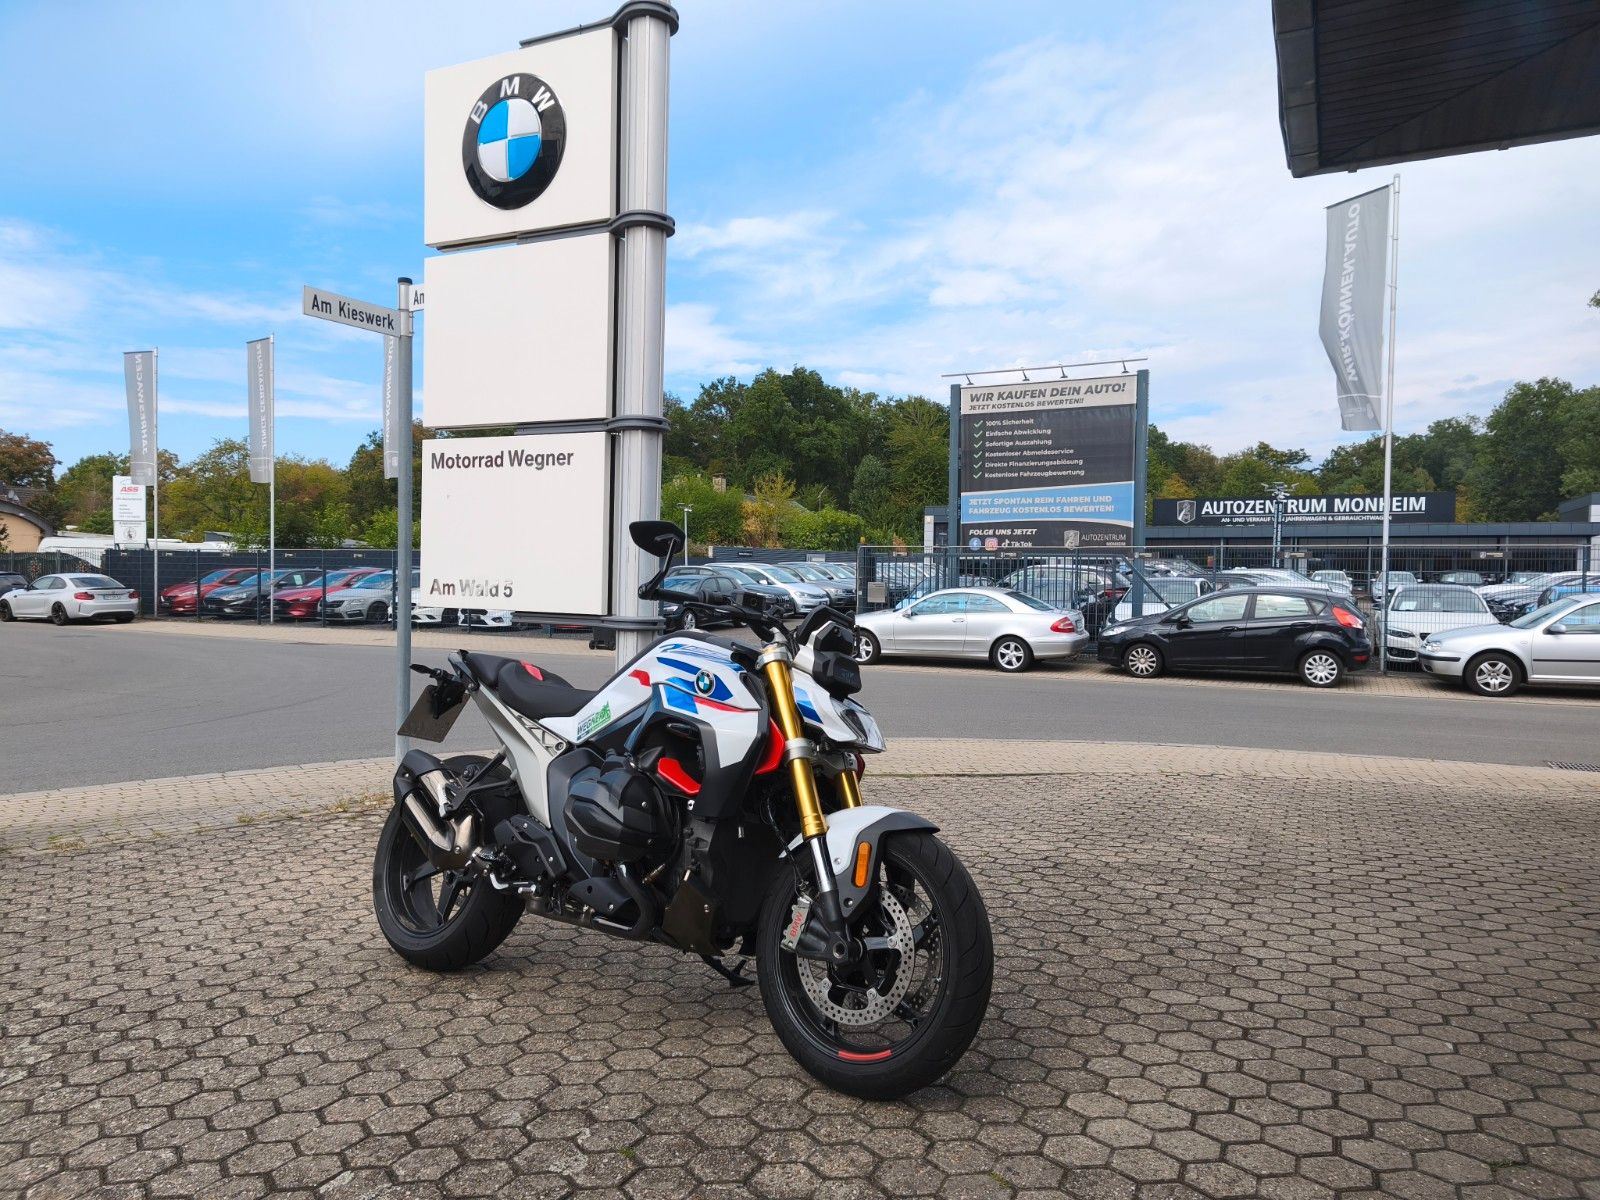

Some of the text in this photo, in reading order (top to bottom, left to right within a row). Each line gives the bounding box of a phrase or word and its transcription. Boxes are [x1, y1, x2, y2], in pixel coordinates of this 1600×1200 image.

[470, 76, 555, 125] BMW
[311, 294, 395, 331] Am Kieswerk
[969, 383, 1127, 403] WIR KAUFEN DEIN AUTO!
[969, 403, 991, 411] JETZT
[992, 401, 1035, 409] KOSTENLOS
[1002, 418, 1034, 426] Sicherheit
[1013, 428, 1052, 436] Abwicklung
[1022, 448, 1074, 456] Abmeldeservice
[431, 449, 574, 470] Motorrad Wegner
[1020, 469, 1085, 478] Fahrzeugbewertung
[969, 498, 992, 506] JETZT
[993, 497, 1032, 505] SPONTAN
[1093, 495, 1113, 503] UND
[969, 505, 1114, 515] FAHRZEUG KOSTENLOS BEWERTEN!
[1081, 533, 1127, 541] AUTOZENTRUM
[430, 578, 514, 598] Am Wald 5
